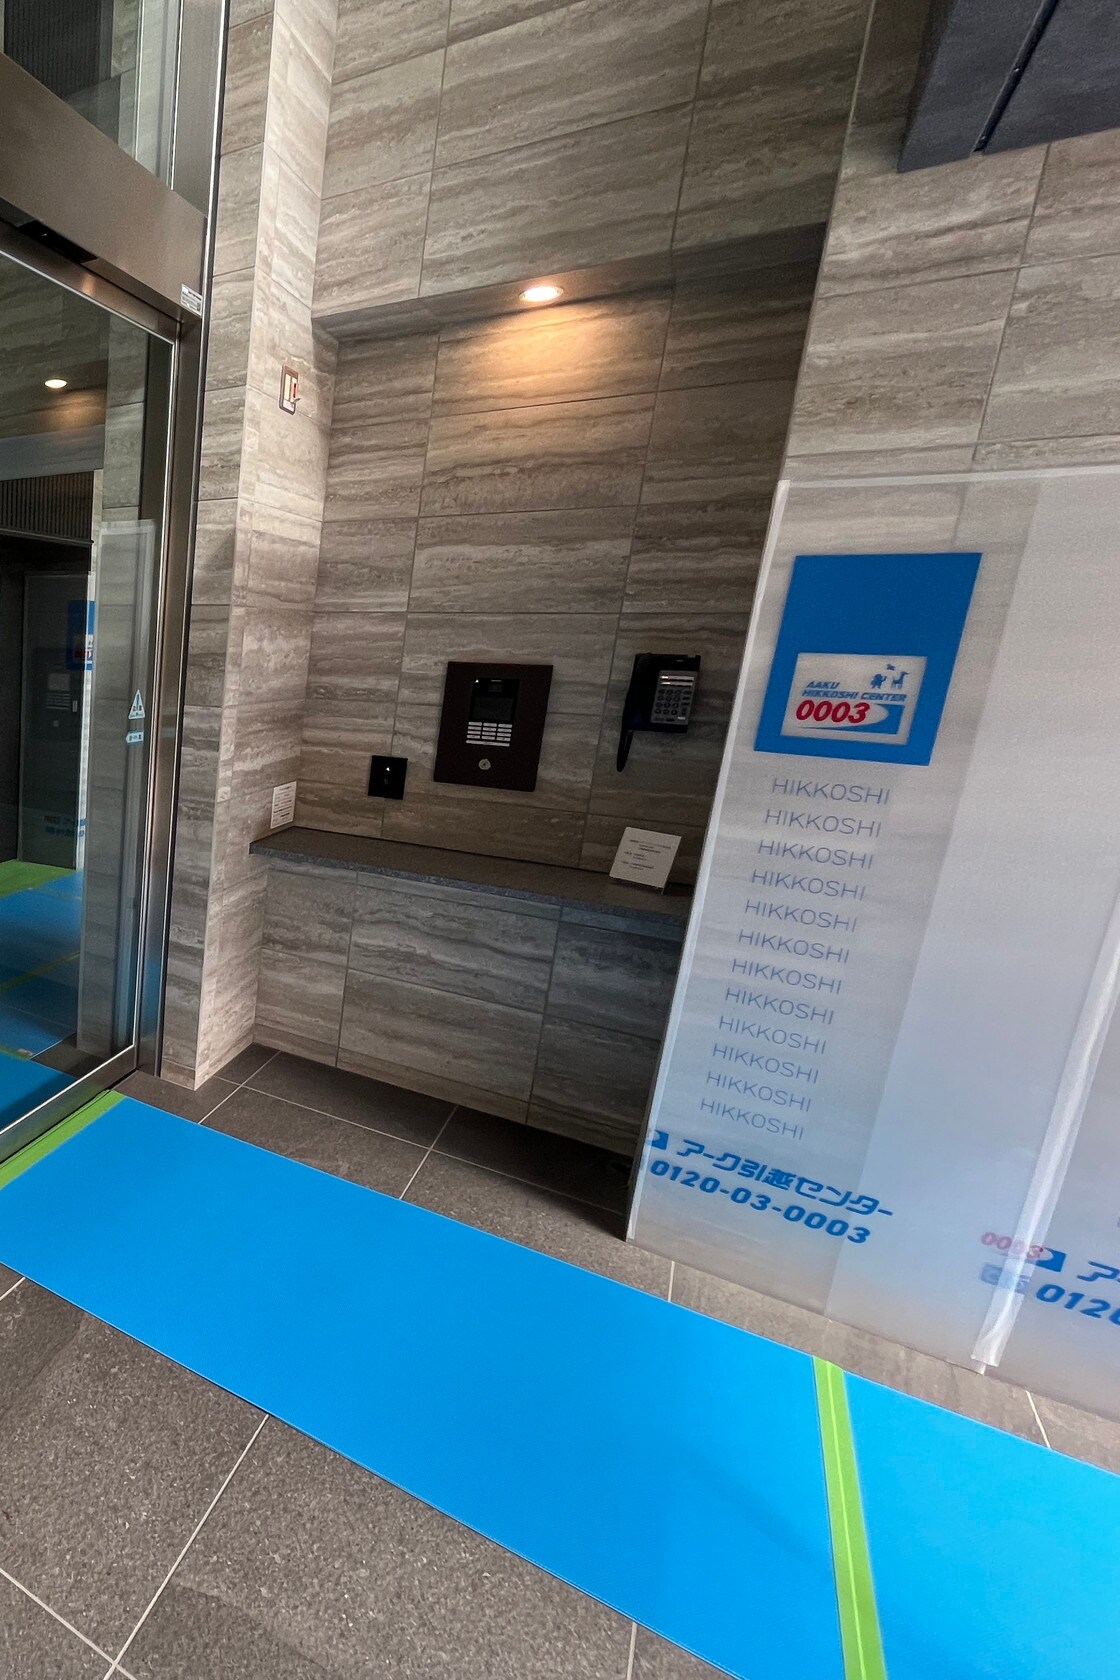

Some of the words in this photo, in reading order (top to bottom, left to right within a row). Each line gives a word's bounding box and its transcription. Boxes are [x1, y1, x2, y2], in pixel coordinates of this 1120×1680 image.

[801, 689, 859, 700] HIKKOSHI
[860, 691, 908, 702] CENTER
[805, 680, 841, 690] AAKU
[796, 699, 871, 724] 0003
[772, 777, 891, 805] HIKKOSHI
[765, 808, 882, 837] HIKKOSHI
[757, 839, 874, 870] HIKKOSHI
[751, 868, 866, 901] HIKKOSHI
[744, 899, 858, 933] HIKKOSHI
[738, 929, 850, 964] HIKKOSHI
[731, 958, 842, 995] HIKKOSHI
[725, 987, 834, 1025] HIKKOSHI
[719, 1015, 827, 1055] HIKKOSHI
[712, 1043, 819, 1084] HIKKOSHI
[706, 1070, 811, 1112] HIKKOSHI
[700, 1098, 804, 1141] HIKKOSHI
[677, 1138, 894, 1217] アーク引越センター
[650, 1160, 871, 1244] 0120-03-0003
